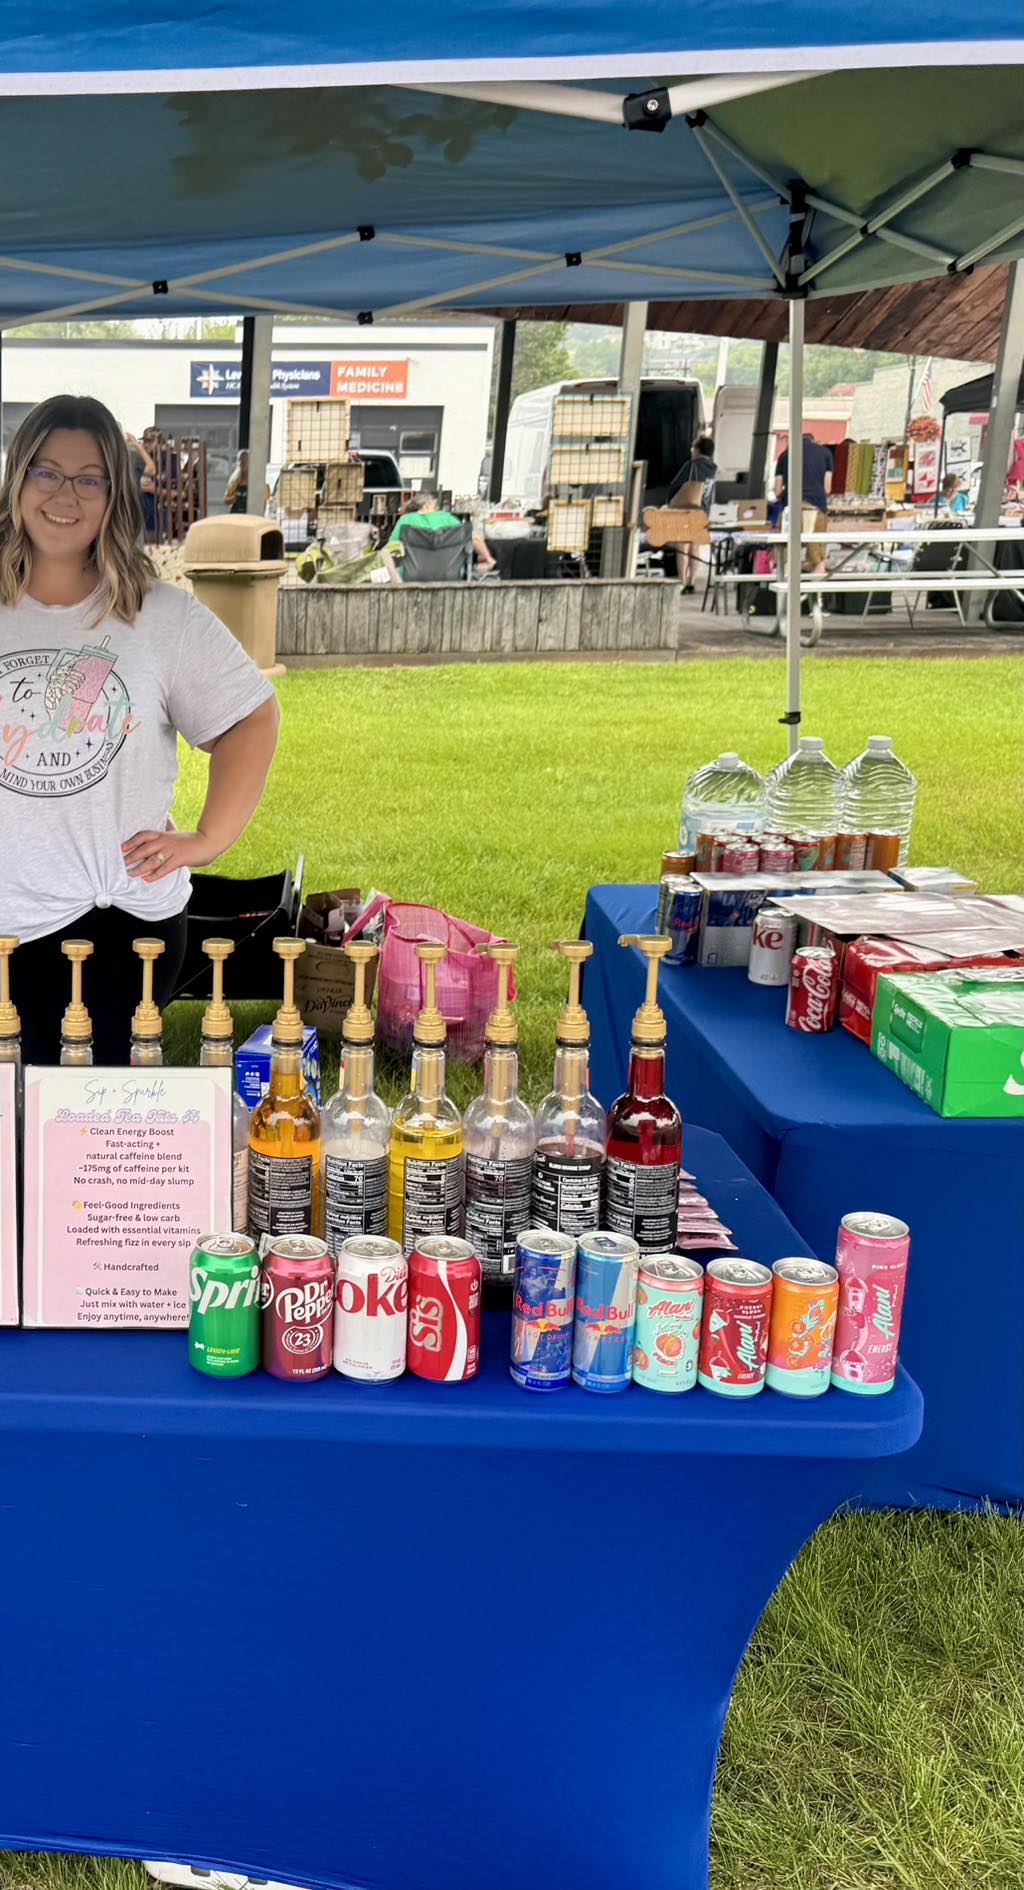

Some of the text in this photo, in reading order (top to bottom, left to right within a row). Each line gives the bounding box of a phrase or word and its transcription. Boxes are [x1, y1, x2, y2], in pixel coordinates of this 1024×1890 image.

[337, 367, 387, 378] FAMILY
[337, 382, 403, 393] MEDICINE
[3, 655, 50, 670] FORGET
[10, 677, 41, 703] to
[37, 752, 71, 766] AND
[0, 769, 27, 788] MIND
[31, 780, 56, 791] YOUR
[60, 773, 84, 790] OWN
[753, 922, 784, 950] ke
[117, 1128, 147, 1137] Energy
[106, 1140, 151, 1150] Fast-acting
[119, 1152, 155, 1160] caffeine
[157, 1152, 182, 1160] blend
[112, 1164, 121, 1172] of
[123, 1164, 159, 1172] caffeine
[161, 1166, 176, 1174] per
[178, 1164, 189, 1172] kit
[74, 1177, 86, 1185] No
[88, 1177, 114, 1186] crash,
[130, 1177, 166, 1186] mid-day
[168, 1177, 194, 1186] slump
[84, 1201, 180, 1211] Feel-Good Ingredients
[87, 1214, 133, 1224] Sugar-free
[67, 1226, 200, 1234] Loaded with essential vitamins
[76, 1238, 123, 1248] Refreshing
[125, 1238, 139, 1246] fizz
[142, 1238, 149, 1246] in
[179, 1239, 191, 1248] sip
[104, 1263, 159, 1271] Handcrafted
[85, 1288, 111, 1297] Quick
[120, 1288, 140, 1297] Easy
[154, 1288, 177, 1296] Make
[190, 1265, 262, 1314] Spri
[304, 1280, 328, 1304] Dr
[336, 1274, 408, 1316] oke
[101, 1300, 117, 1308] mix
[119, 1300, 138, 1308] with
[174, 1300, 186, 1308] ice
[276, 1288, 334, 1324] Peppe
[516, 1295, 573, 1317] Red Bull
[577, 1297, 634, 1320] Red Bull
[78, 1313, 102, 1322] Enjoy
[104, 1313, 142, 1322] anytime,
[294, 1333, 311, 1346] 23
